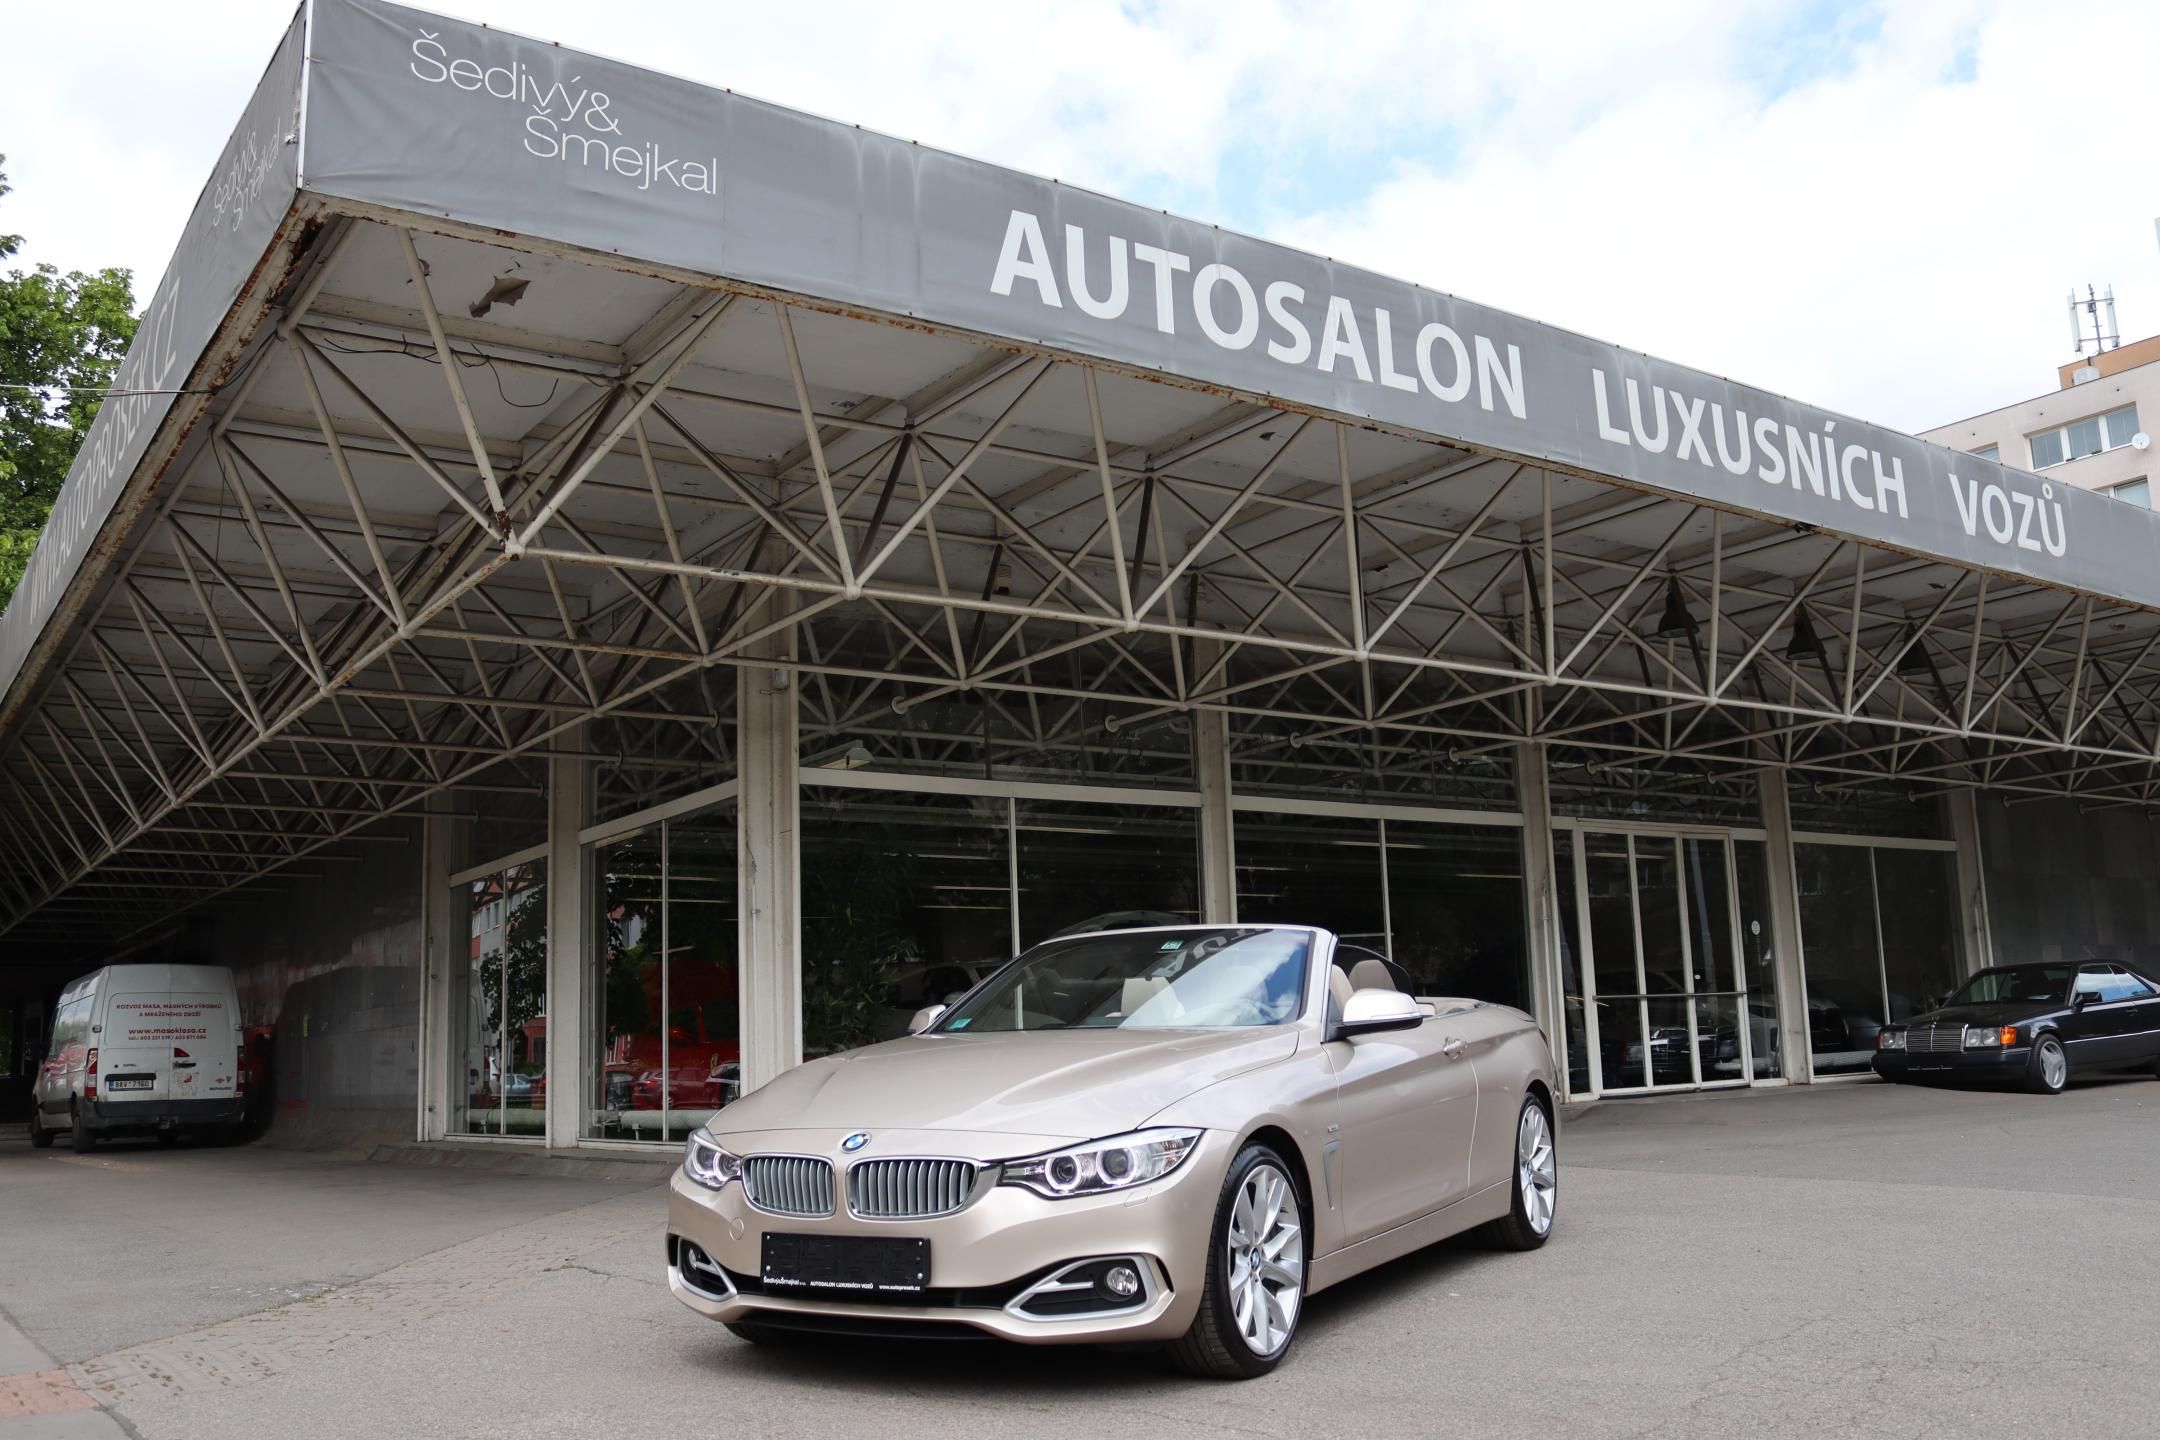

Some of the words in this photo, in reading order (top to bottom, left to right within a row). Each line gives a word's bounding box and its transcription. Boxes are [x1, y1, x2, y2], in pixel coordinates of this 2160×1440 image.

[410, 27, 623, 135] Šedivý&
[524, 104, 717, 195] Šmejkal
[990, 209, 1527, 420] AUTOSALON
[1592, 368, 1909, 520] LUXUSNÍCH
[1949, 472, 2067, 558] VOZŮ
[810, 1280, 836, 1288] AUTOSALON
